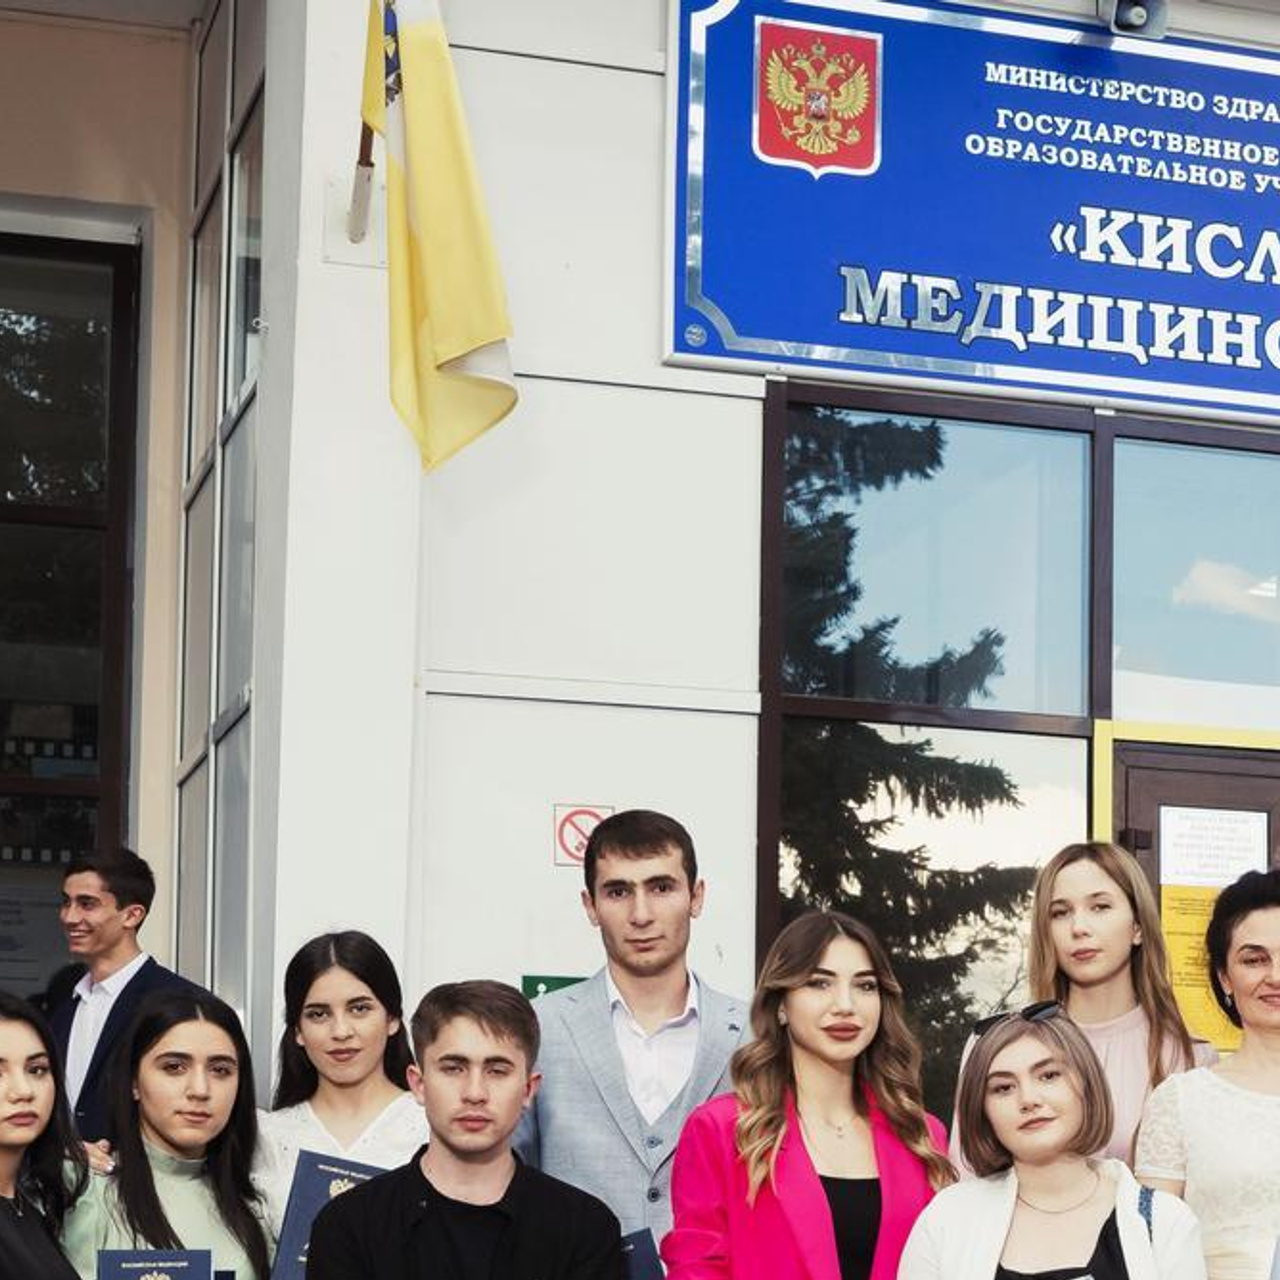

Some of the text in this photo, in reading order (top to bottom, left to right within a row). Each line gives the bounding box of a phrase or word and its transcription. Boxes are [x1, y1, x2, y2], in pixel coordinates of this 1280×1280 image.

[985, 61, 1205, 112] МИНИСТЕРСТВО
[965, 134, 1246, 191] ОБРАЗОВАТЕЛЬНОЕ
[996, 108, 1279, 166] ГОСУДАРСТВЕННОЕ
